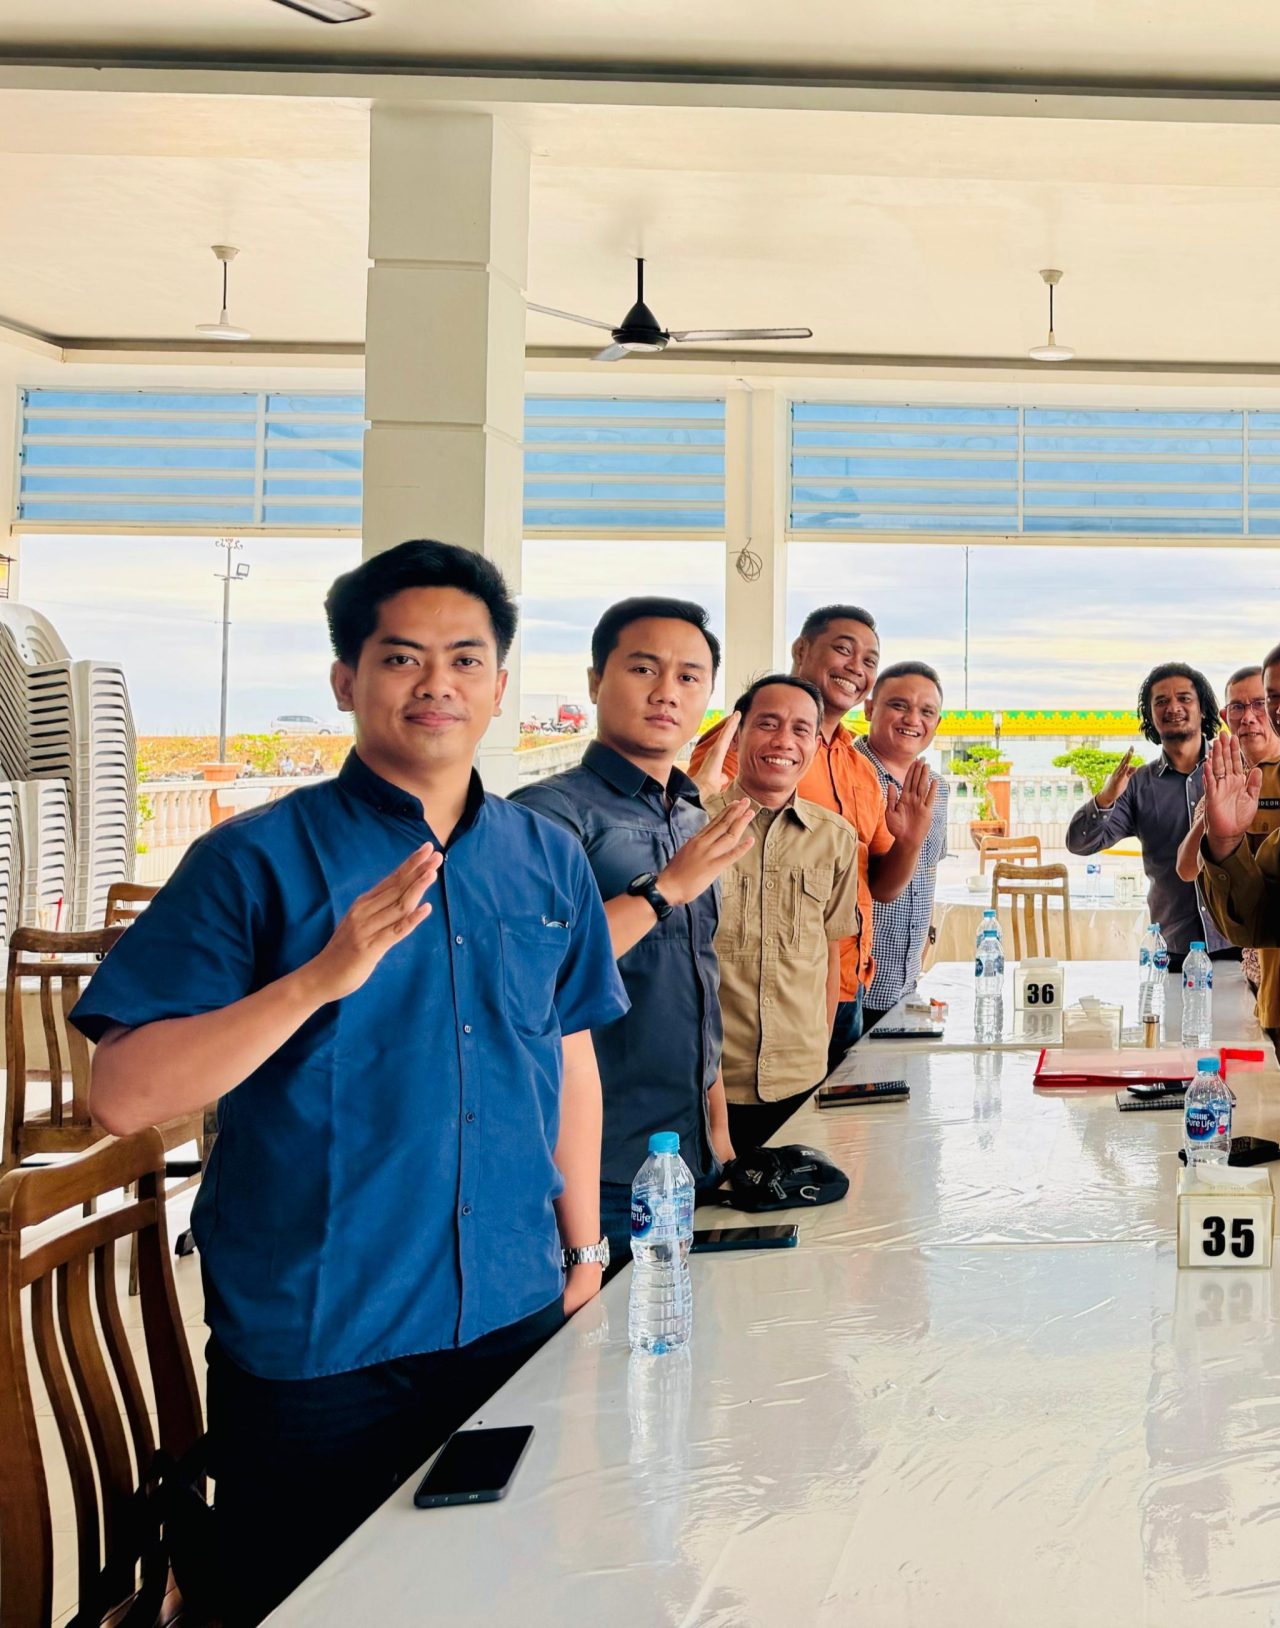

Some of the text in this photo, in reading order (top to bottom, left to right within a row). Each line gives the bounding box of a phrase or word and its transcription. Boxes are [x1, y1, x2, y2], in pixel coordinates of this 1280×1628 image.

[1027, 983, 1055, 1004] 36
[1202, 1120, 1215, 1131] Life
[636, 1212, 651, 1226] Life
[1202, 1216, 1255, 1258] 35
